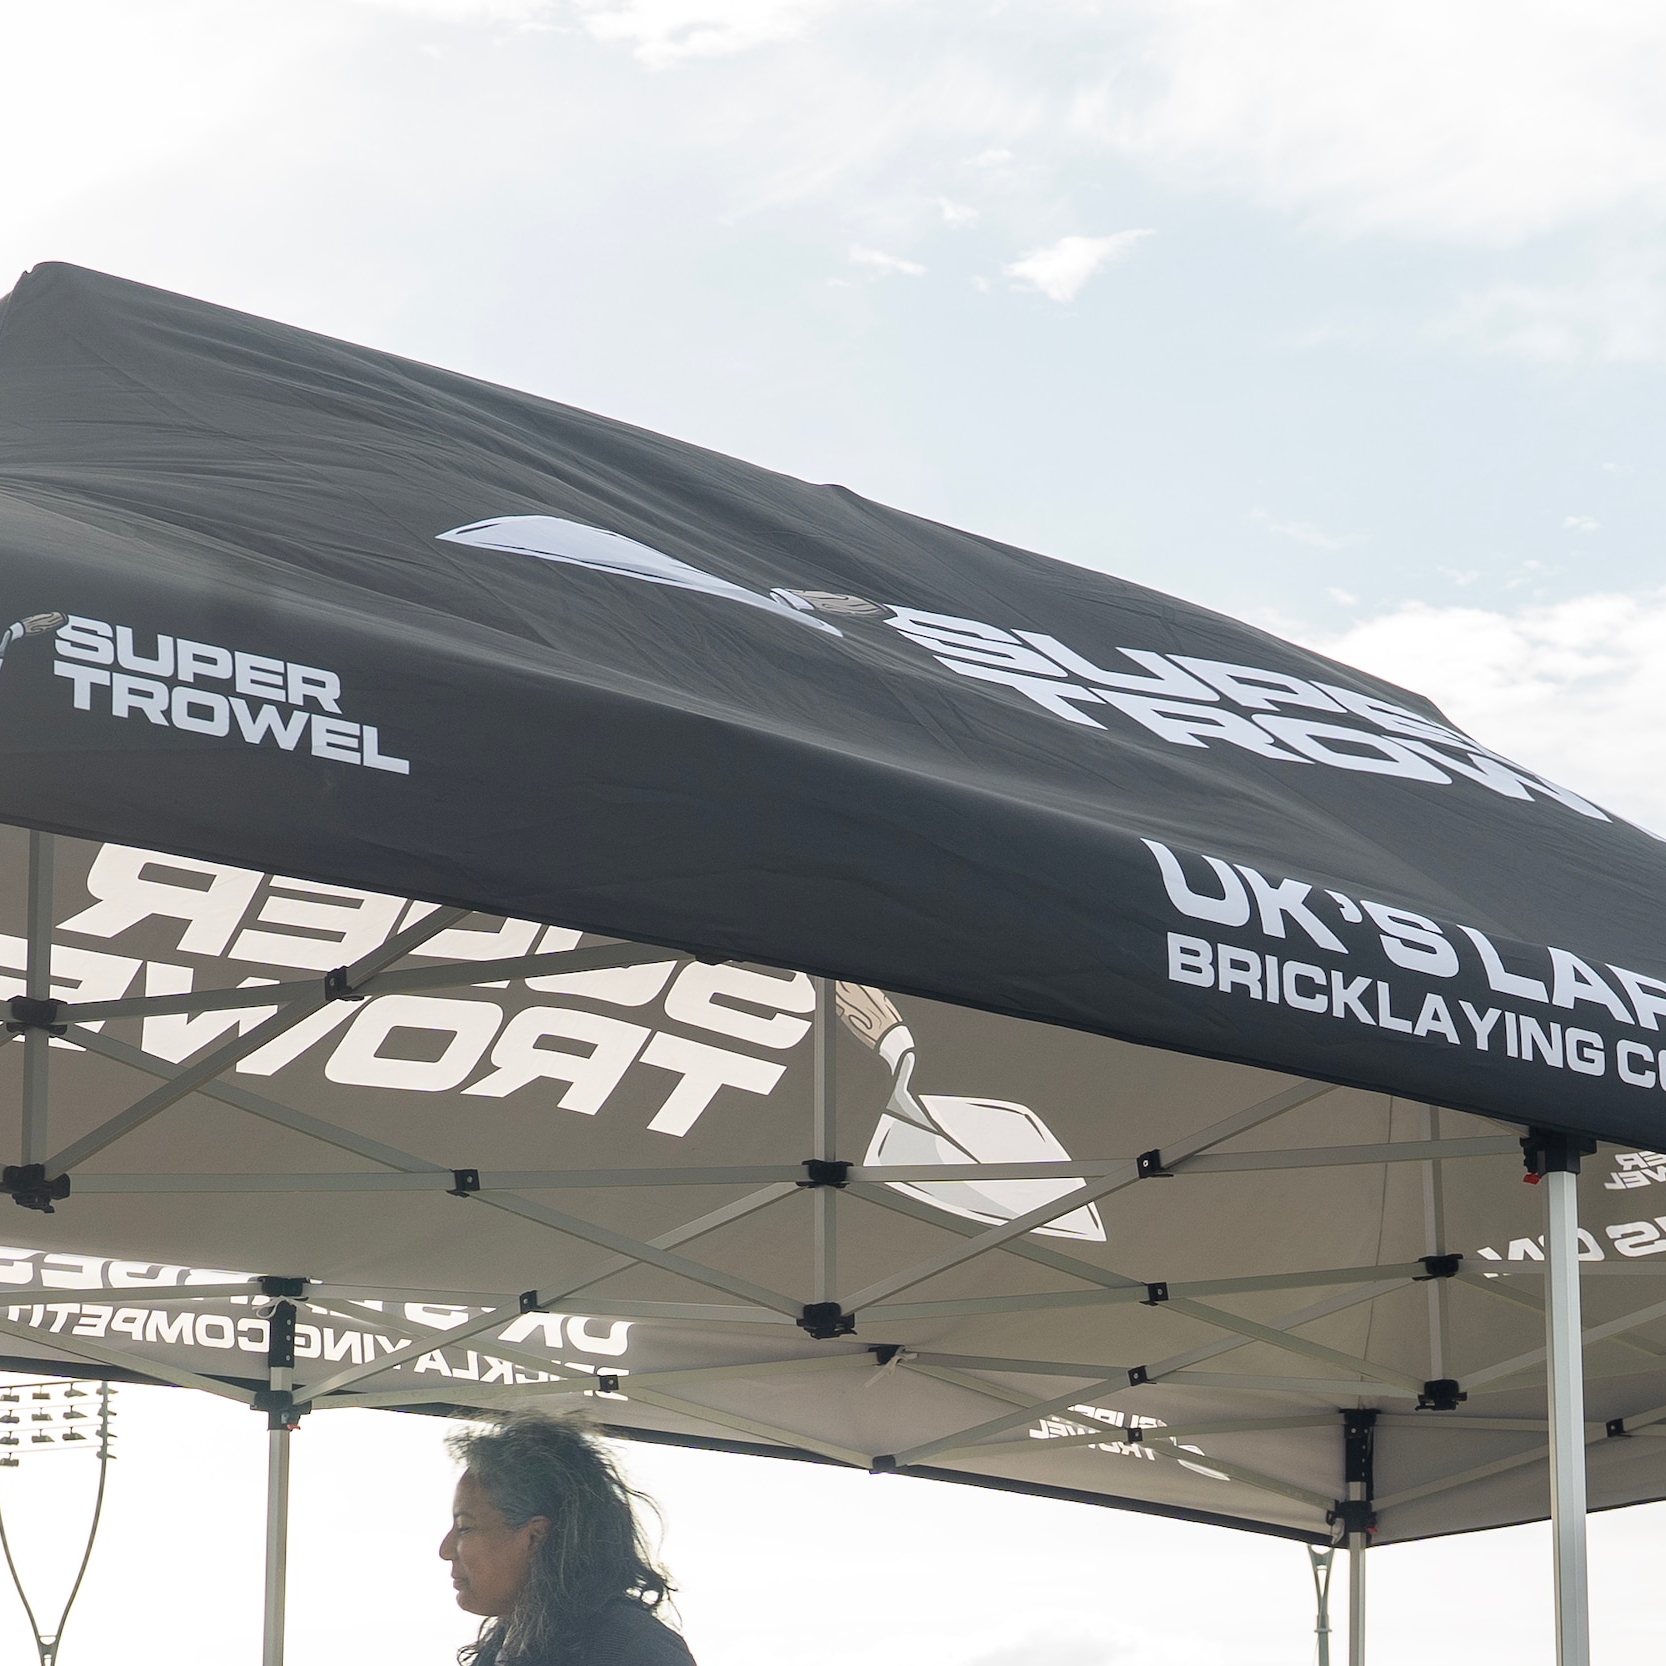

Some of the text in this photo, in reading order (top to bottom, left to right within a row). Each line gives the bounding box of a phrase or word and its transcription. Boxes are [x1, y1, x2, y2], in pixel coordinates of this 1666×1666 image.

[53, 659, 410, 775] TROWEL
[54, 613, 343, 714] SUPER
[882, 603, 1483, 756] SUPE
[933, 655, 1614, 825] TROW
[1141, 837, 1461, 979] UK'S
[1166, 931, 1607, 1078] BRICKLAYING
